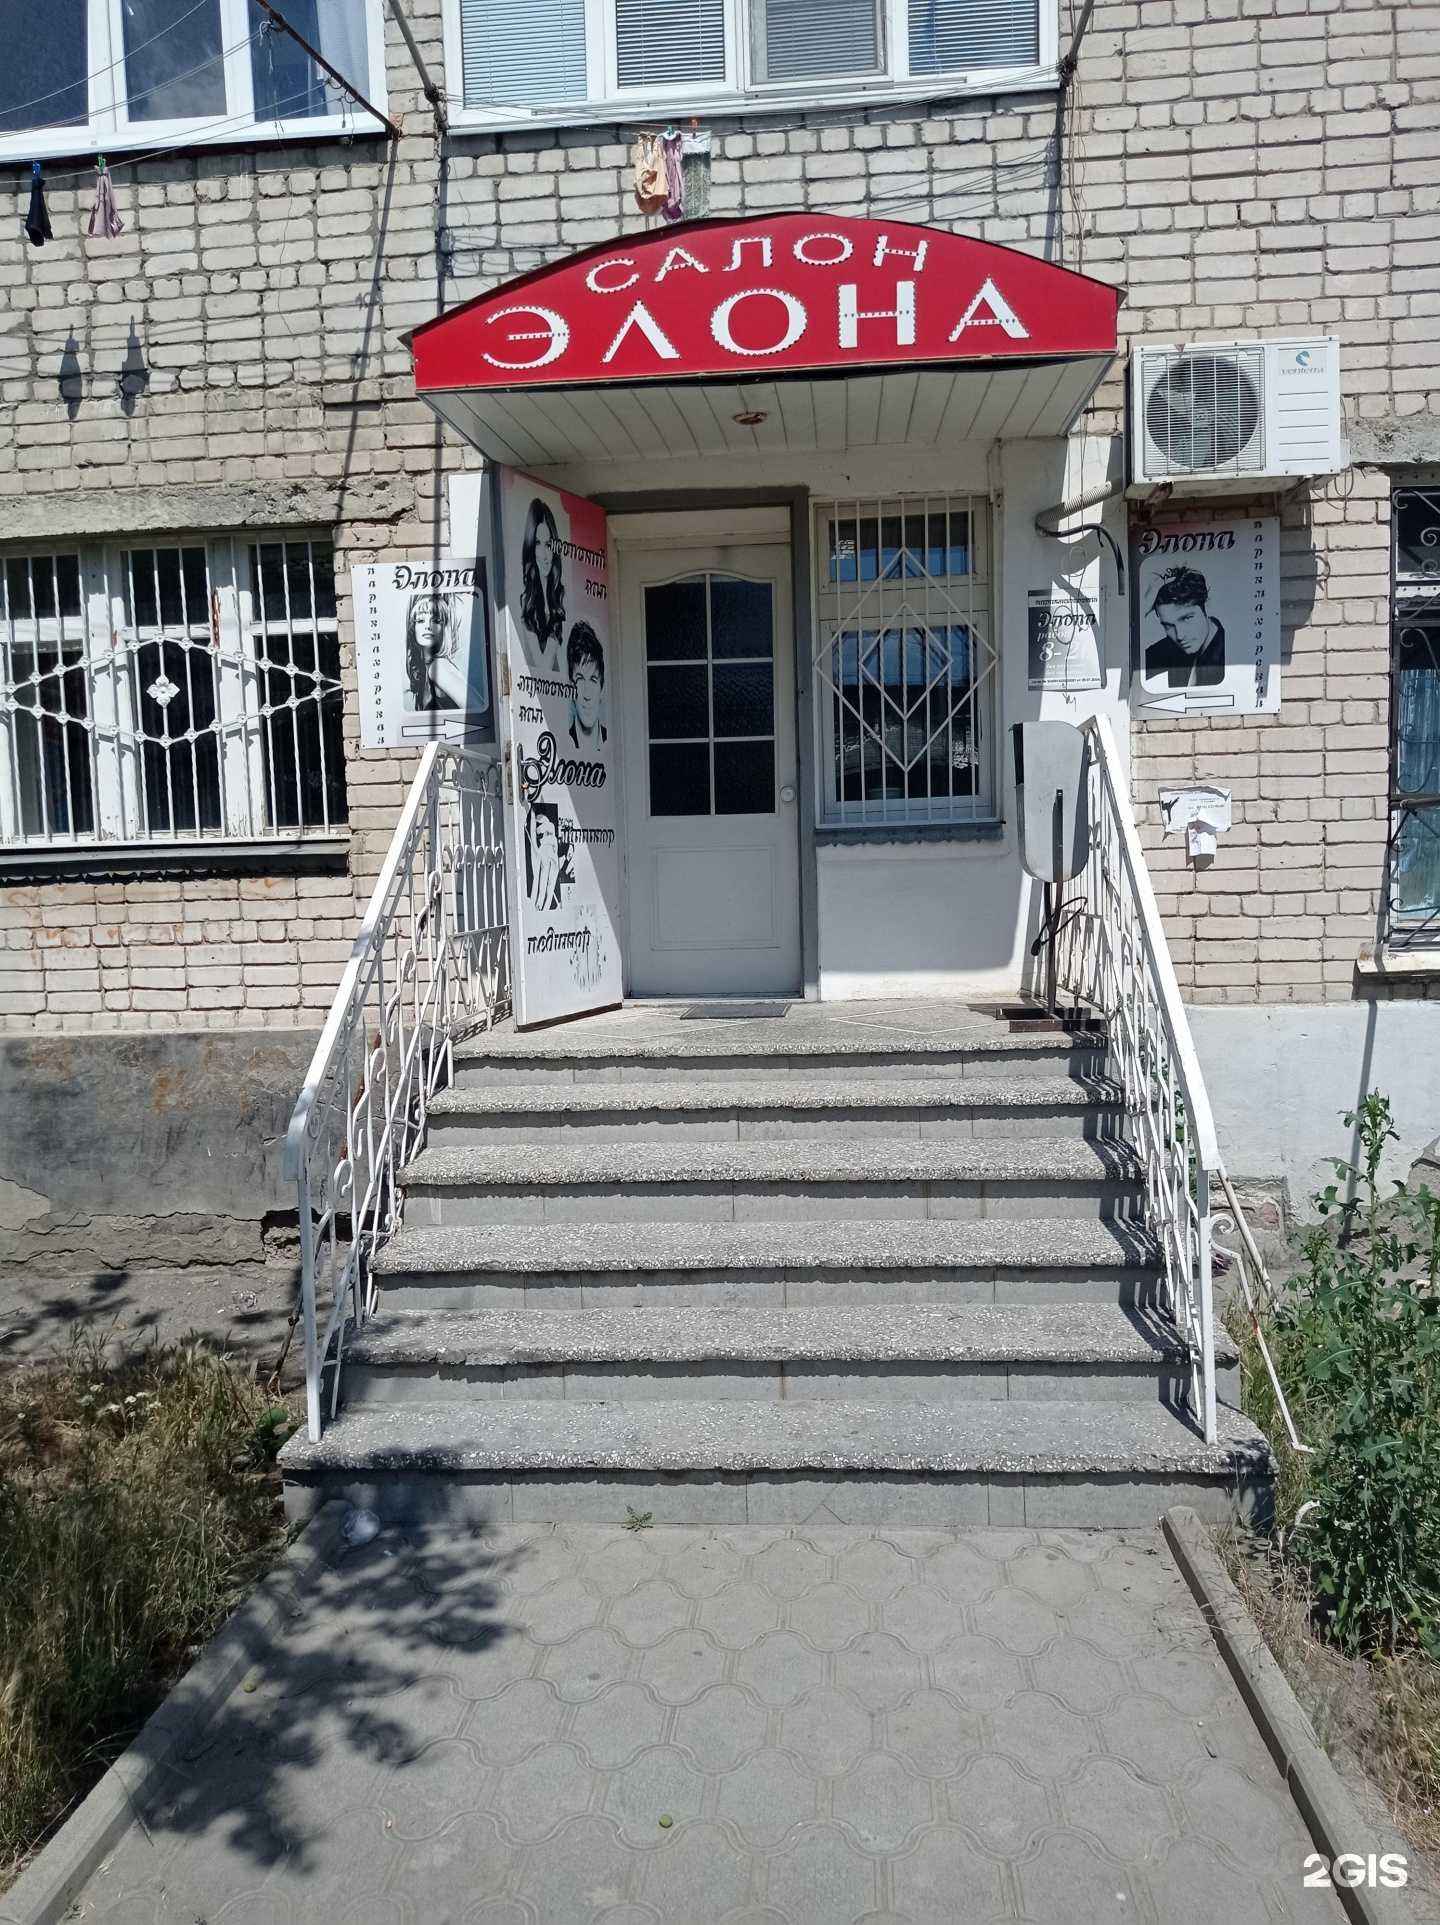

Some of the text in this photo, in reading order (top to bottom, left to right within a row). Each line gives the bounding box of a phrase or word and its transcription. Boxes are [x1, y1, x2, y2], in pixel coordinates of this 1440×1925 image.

[586, 233, 927, 294] САЛОН
[482, 276, 1030, 370] ЭЛОНА
[520, 731, 607, 802] Элона
[527, 926, 591, 955] педикюр
